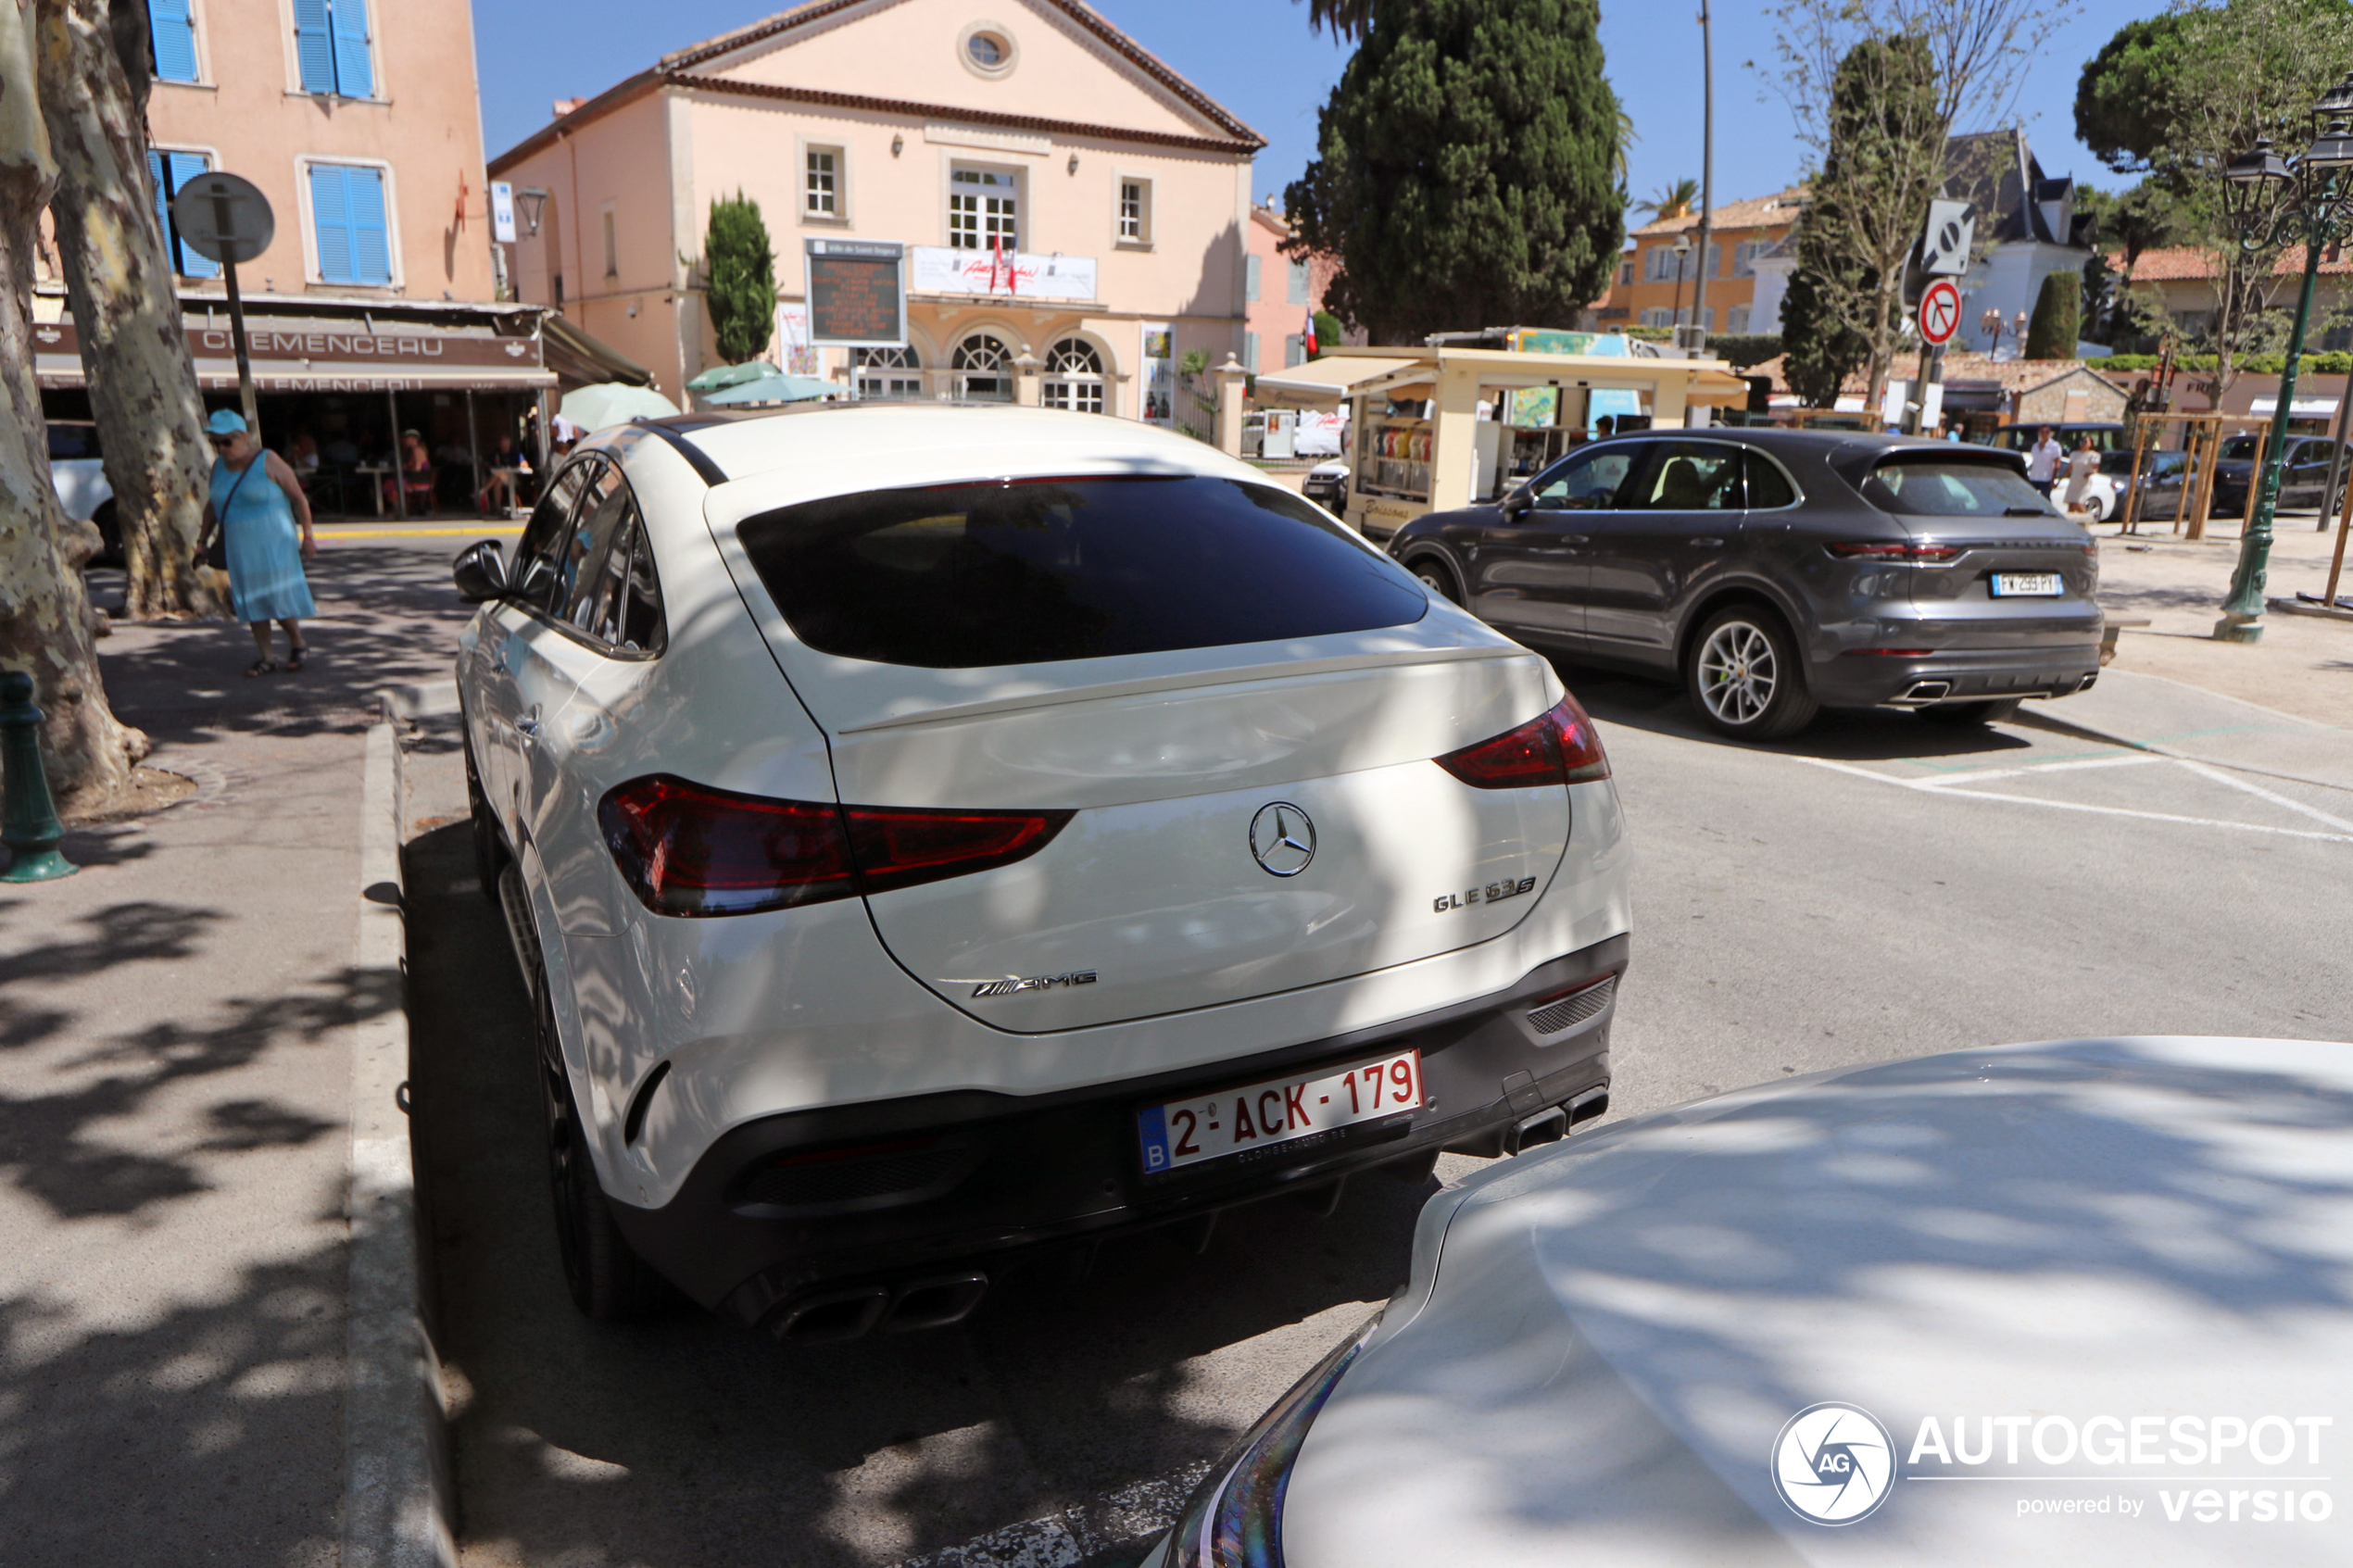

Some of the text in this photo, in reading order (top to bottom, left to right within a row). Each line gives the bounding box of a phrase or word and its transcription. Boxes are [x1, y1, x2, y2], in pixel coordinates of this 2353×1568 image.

[1432, 887, 1481, 914] GLE
[1009, 969, 1100, 993] AMG
[1148, 1145, 1165, 1168] B
